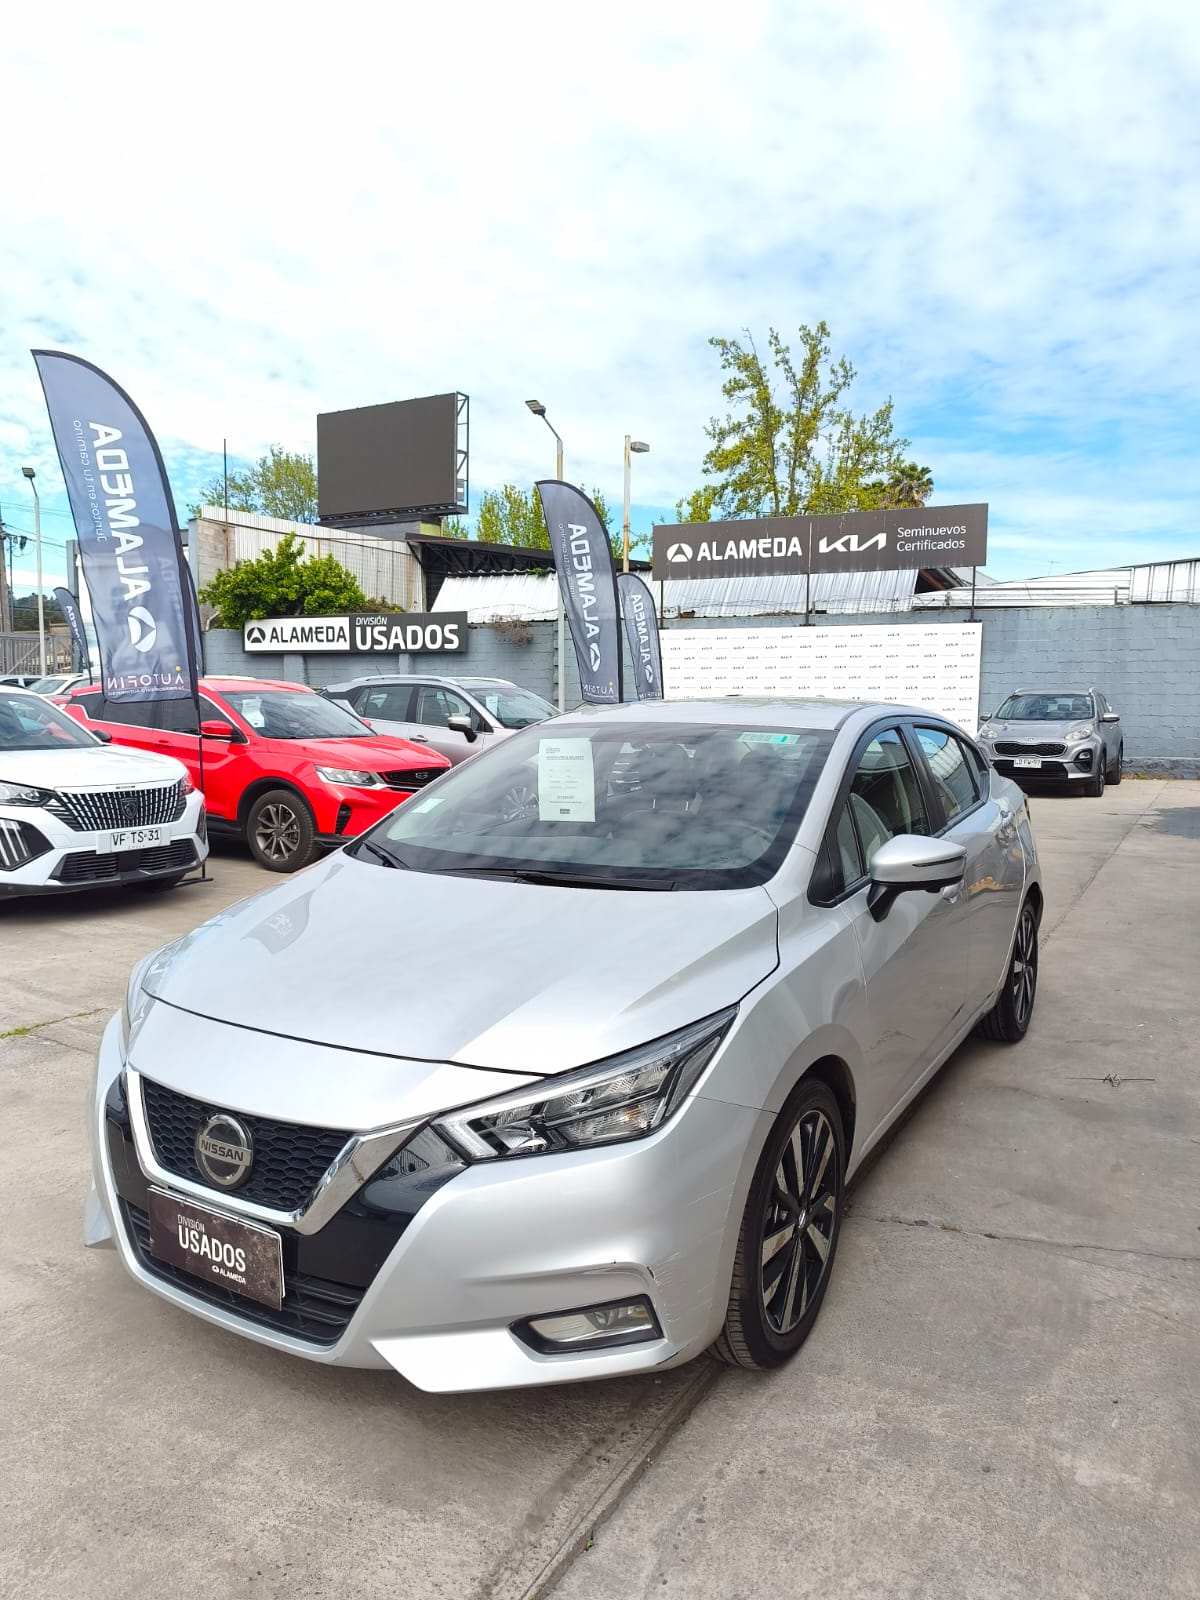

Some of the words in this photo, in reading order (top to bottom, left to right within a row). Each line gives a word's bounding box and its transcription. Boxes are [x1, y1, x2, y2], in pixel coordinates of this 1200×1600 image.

[897, 524, 967, 538] Seminuevos
[697, 537, 803, 561] ALAMEDA
[897, 539, 965, 552] Certificados
[356, 616, 388, 625] DIVISIÓN
[269, 626, 348, 643] ALAMEDA
[356, 624, 459, 650] USADOS
[200, 1139, 244, 1162] NISSAN
[177, 1214, 205, 1233] DIVISIÓN
[178, 1224, 246, 1272] USADOS
[219, 1268, 247, 1285] ALAMEDA
